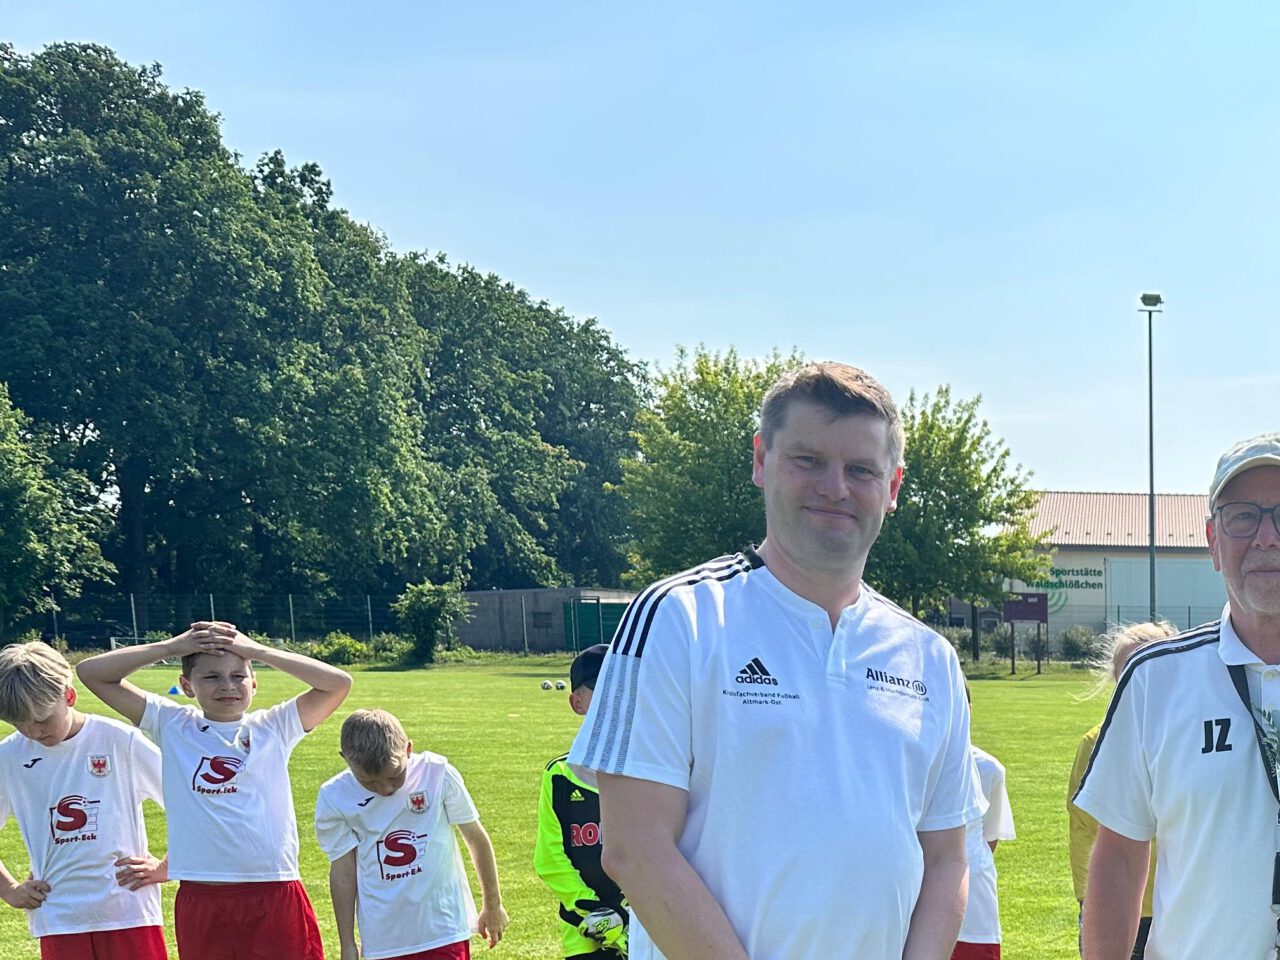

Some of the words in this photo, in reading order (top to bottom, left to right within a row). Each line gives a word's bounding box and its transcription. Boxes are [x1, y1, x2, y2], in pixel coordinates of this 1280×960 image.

[1050, 567, 1103, 578] Sportstätte
[735, 674, 779, 686] adidas
[866, 668, 912, 689] Allianz
[1202, 718, 1232, 754] JZ
[54, 833, 97, 845] Sport-Eck
